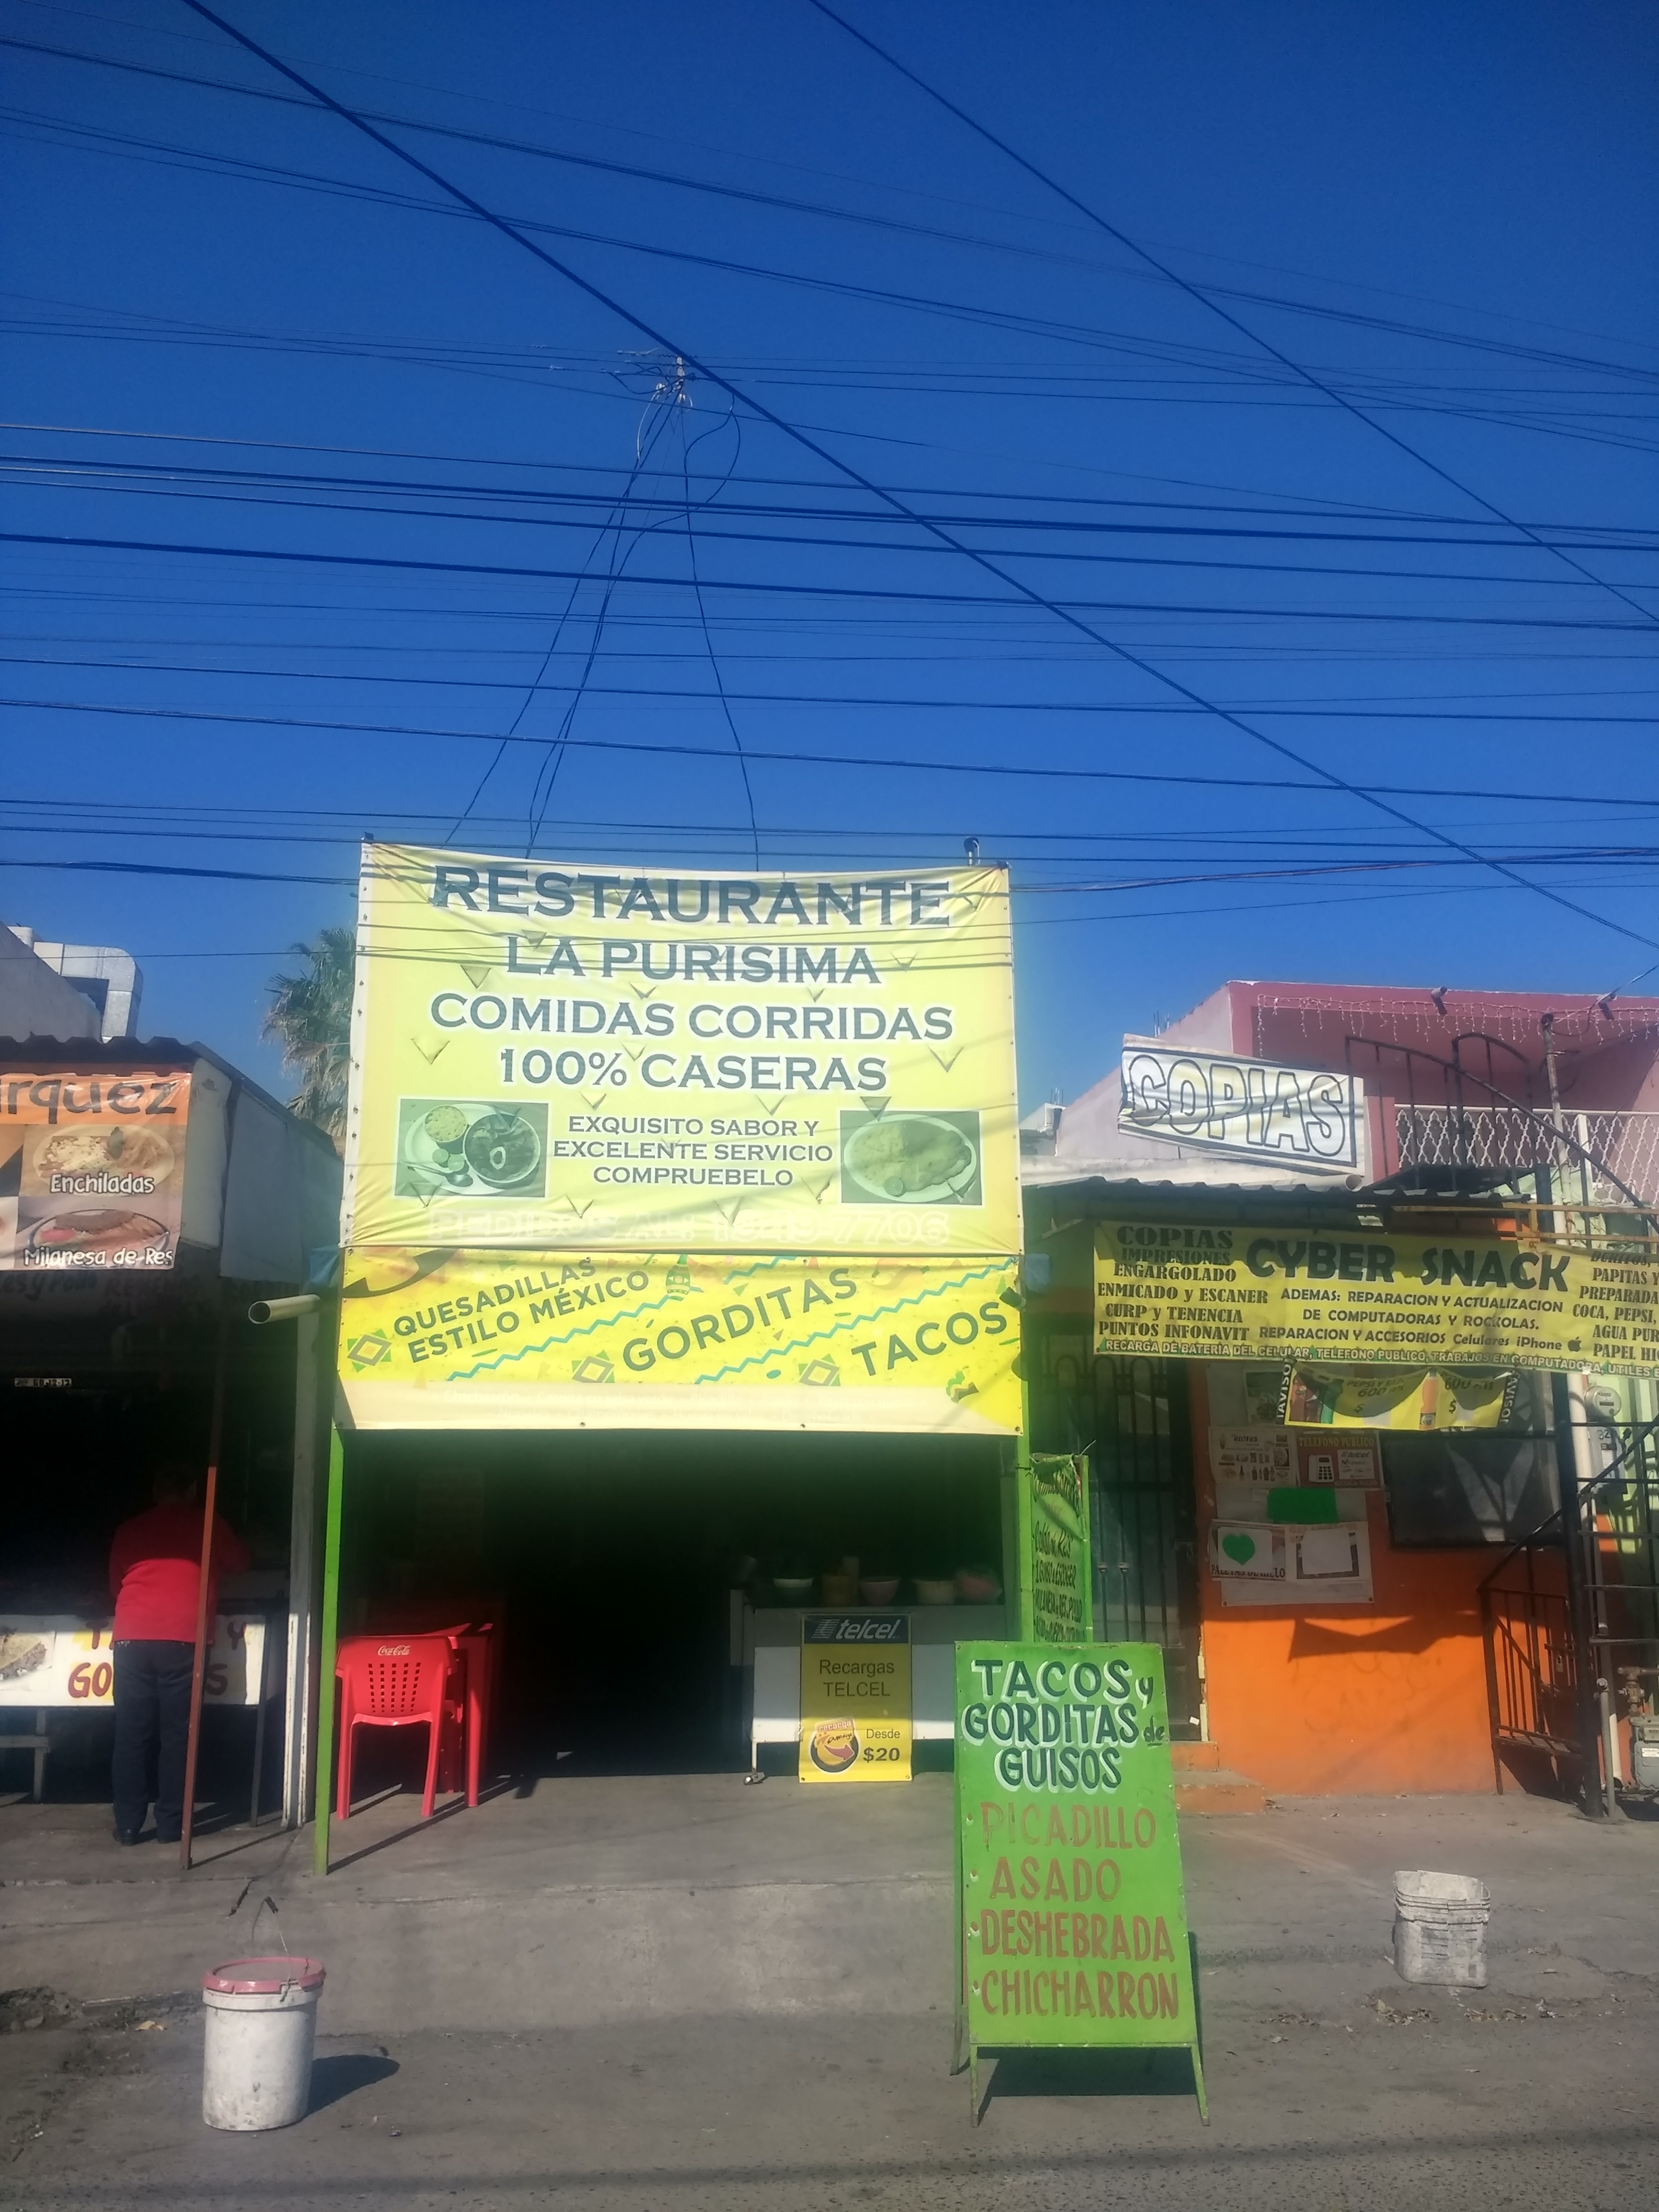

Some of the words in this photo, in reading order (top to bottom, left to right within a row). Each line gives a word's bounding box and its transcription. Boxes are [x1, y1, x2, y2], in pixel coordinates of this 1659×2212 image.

[432, 866, 950, 926] RESTAURANTE
[507, 936, 585, 976] LA
[601, 942, 882, 984] PURISIMA
[431, 993, 674, 1036] COMIDAS
[689, 1004, 953, 1040] CORRIDAS
[501, 1049, 627, 1086] 100%
[641, 1053, 887, 1091] CASERAS
[0, 1078, 177, 1124] rquez
[1129, 1054, 1345, 1157] COPIAS
[568, 1116, 703, 1135] EXQUISITO
[710, 1119, 797, 1137] SABOR
[803, 1120, 819, 1137] Y
[553, 1141, 708, 1160] EXCELENTE
[714, 1143, 833, 1162] SERVICIO
[51, 1172, 155, 1194] Enchiladas
[593, 1166, 793, 1186] COMPRUEBELO
[1117, 1226, 1233, 1249] COPIAS
[23, 1246, 106, 1266] Milanesa
[113, 1247, 137, 1265] de
[145, 1247, 173, 1266] Res
[1121, 1247, 1231, 1266] IMPRESIONES
[1246, 1239, 1395, 1283] CYBER
[1419, 1247, 1570, 1292] SNACK
[1113, 1263, 1236, 1282] ENGARGOLADO
[1593, 1267, 1647, 1285] PAPITAS
[394, 1259, 597, 1337] QUESADILLAS
[1097, 1283, 1178, 1300] ENMICADO
[1184, 1289, 1194, 1302] y
[1199, 1288, 1268, 1304] ESCANER
[1280, 1288, 1341, 1302] ADEMAS:
[1347, 1291, 1438, 1306] REPARACION
[1442, 1295, 1451, 1306] Y
[1453, 1296, 1563, 1313] ACTUALIZACION
[408, 1311, 520, 1363] ESTILO
[529, 1270, 650, 1324] MÉXICO
[623, 1267, 857, 1371] GORDITAS
[1105, 1303, 1147, 1318] CURP
[1152, 1308, 1161, 1321] y
[1167, 1306, 1243, 1323] TENENCIA
[1303, 1309, 1321, 1320] DE
[1328, 1310, 1441, 1325] COMPUTADORAS
[1448, 1315, 1457, 1326] Y
[1463, 1315, 1539, 1330] ROCKOLAS.
[1572, 1304, 1609, 1321] COCA,
[1614, 1307, 1657, 1325] PEPSI,
[851, 1301, 1008, 1376] TACOS
[1099, 1321, 1159, 1337] PUNTOS
[1164, 1325, 1250, 1341] INFONAVIT
[1259, 1327, 1349, 1340] REPARACION
[1353, 1330, 1362, 1341] Y
[1364, 1330, 1446, 1344] ACCESORIOS
[1453, 1334, 1510, 1346] Celulares
[1516, 1336, 1562, 1350] iPhone
[1593, 1325, 1628, 1340] AGUA
[1105, 1339, 1159, 1352] RECARGA
[1162, 1342, 1178, 1353] DE
[1233, 1345, 1255, 1356] DEL
[1258, 1345, 1313, 1360] CELULAR,
[1316, 1347, 1375, 1360] TELEFONO
[1378, 1350, 1429, 1363] PUBLICO,
[1431, 1351, 1492, 1363] TRABAJOS
[1493, 1353, 1509, 1364] EN
[1511, 1355, 1605, 1375] COMPUTADORA,
[1608, 1363, 1651, 1377] UTILES
[1593, 1343, 1636, 1360] PAPEL
[1358, 1387, 1387, 1397] 600
[1449, 1399, 1457, 1414] $
[1298, 1437, 1338, 1447] TELEFONO
[1342, 1437, 1375, 1447] PUBLICO
[836, 1619, 901, 1640] telcel
[819, 1659, 895, 1678] Recargas
[823, 1682, 891, 1697] TELCEL
[973, 1659, 1130, 1700] TACOS
[1135, 1676, 1154, 1708] y
[818, 1720, 852, 1732] recarga
[866, 1729, 900, 1739] Desde
[962, 1702, 1139, 1747] GORDITAS
[1143, 1716, 1165, 1744] de
[864, 1747, 900, 1763] $20
[994, 1747, 1122, 1792] GUISOS
[979, 1802, 1157, 1849] PICADILLO
[990, 1856, 1121, 1903] ASADO
[979, 1909, 1176, 1962] DESHEBRADA
[982, 1970, 1179, 2020] CHICHARRON
